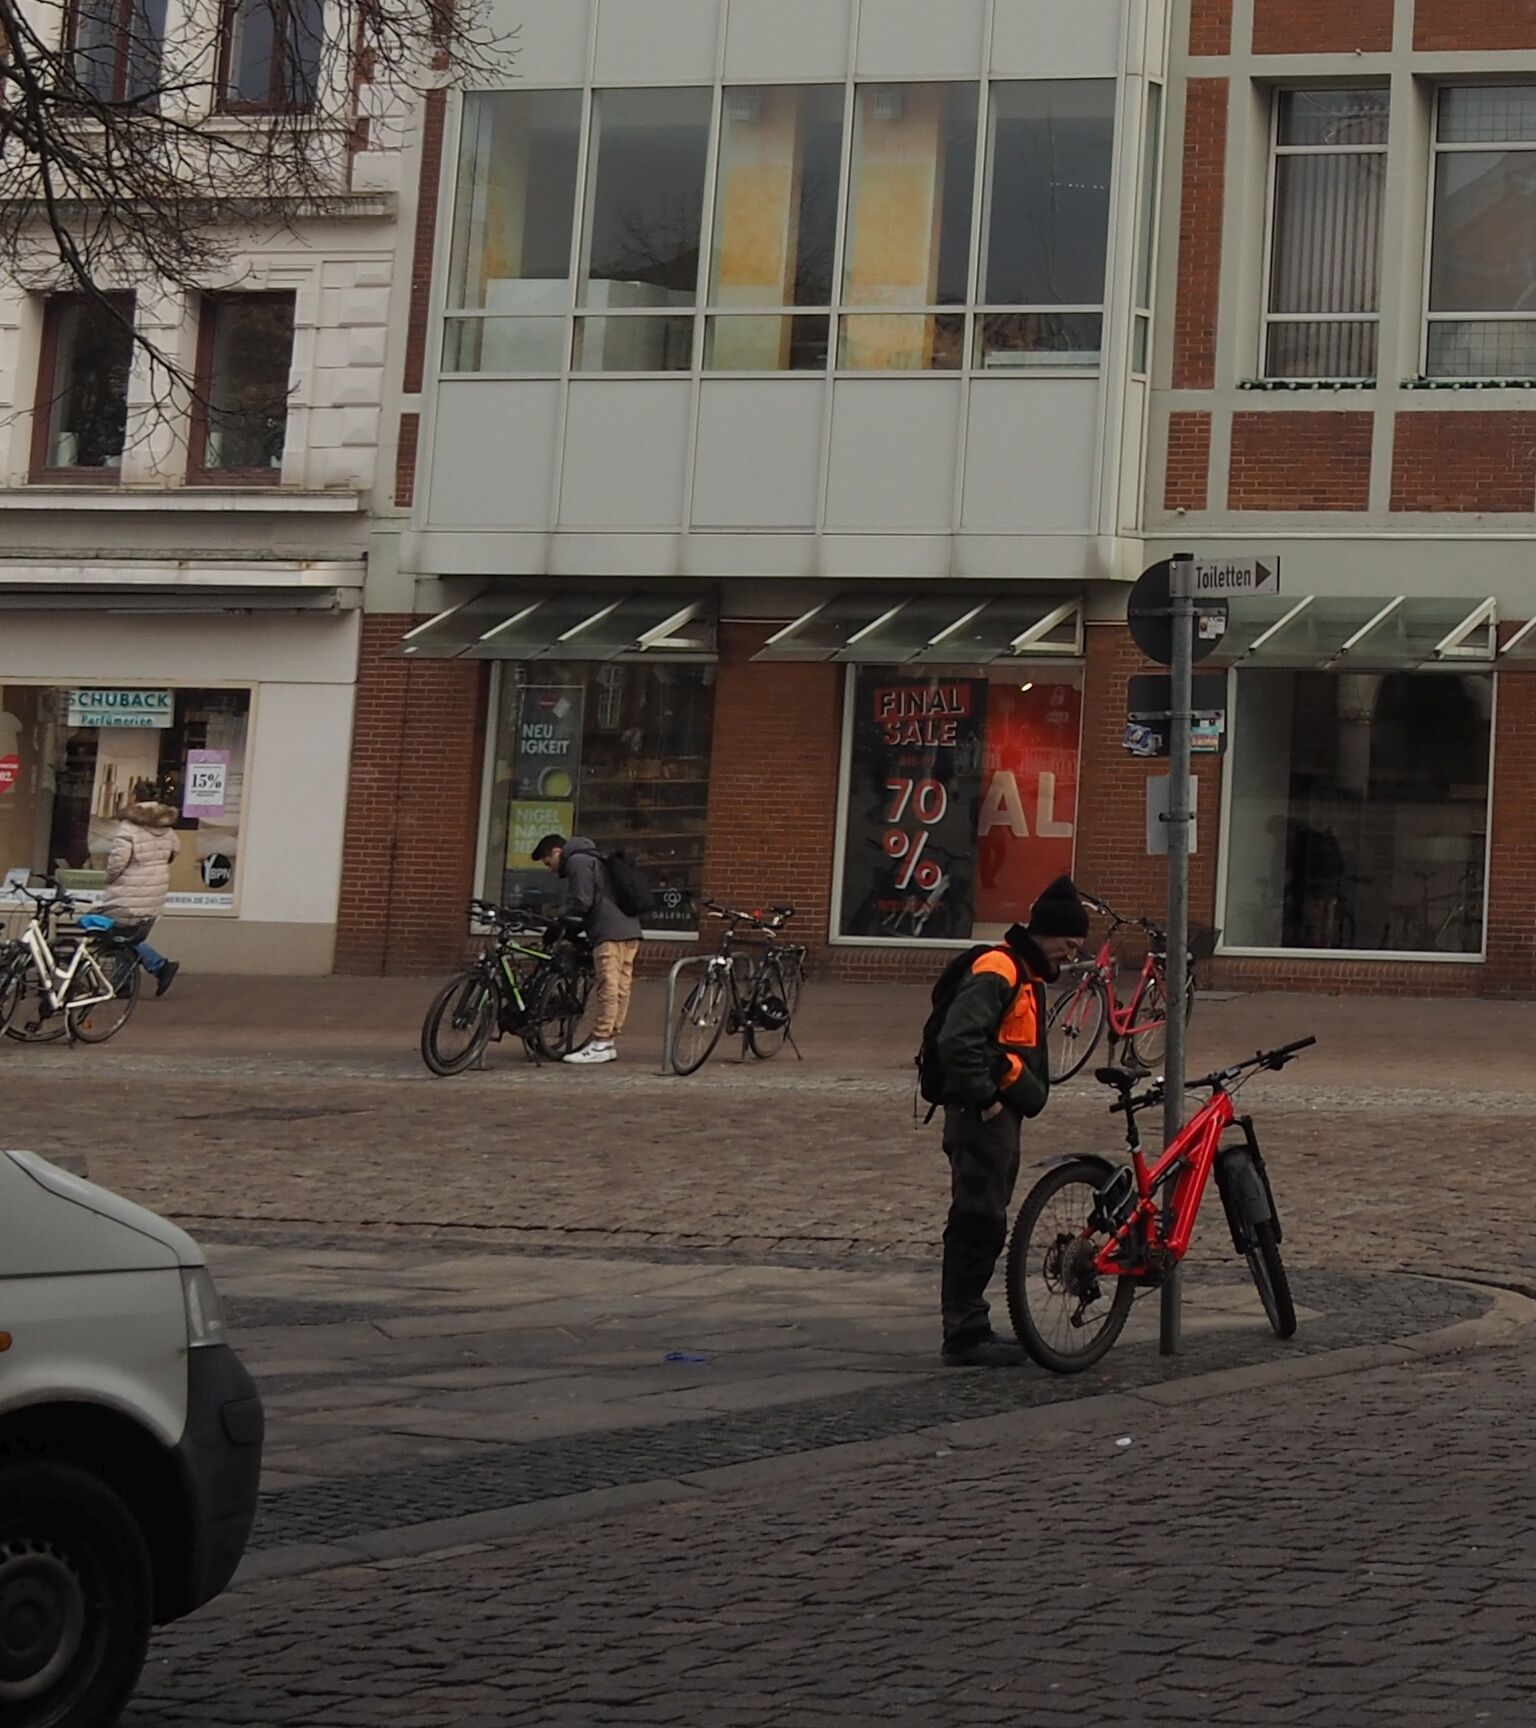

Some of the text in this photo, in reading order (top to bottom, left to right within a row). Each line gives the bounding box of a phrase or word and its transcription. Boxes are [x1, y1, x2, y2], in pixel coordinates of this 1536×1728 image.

[1196, 565, 1251, 589] Toiletten
[880, 688, 966, 718] FINAL
[522, 724, 553, 739] NEU
[884, 720, 958, 747] SALE
[521, 739, 570, 755] IGKEIT
[192, 773, 222, 789] 15%
[885, 777, 948, 824] 70
[516, 808, 560, 823] NIGEL
[882, 828, 943, 891] %
